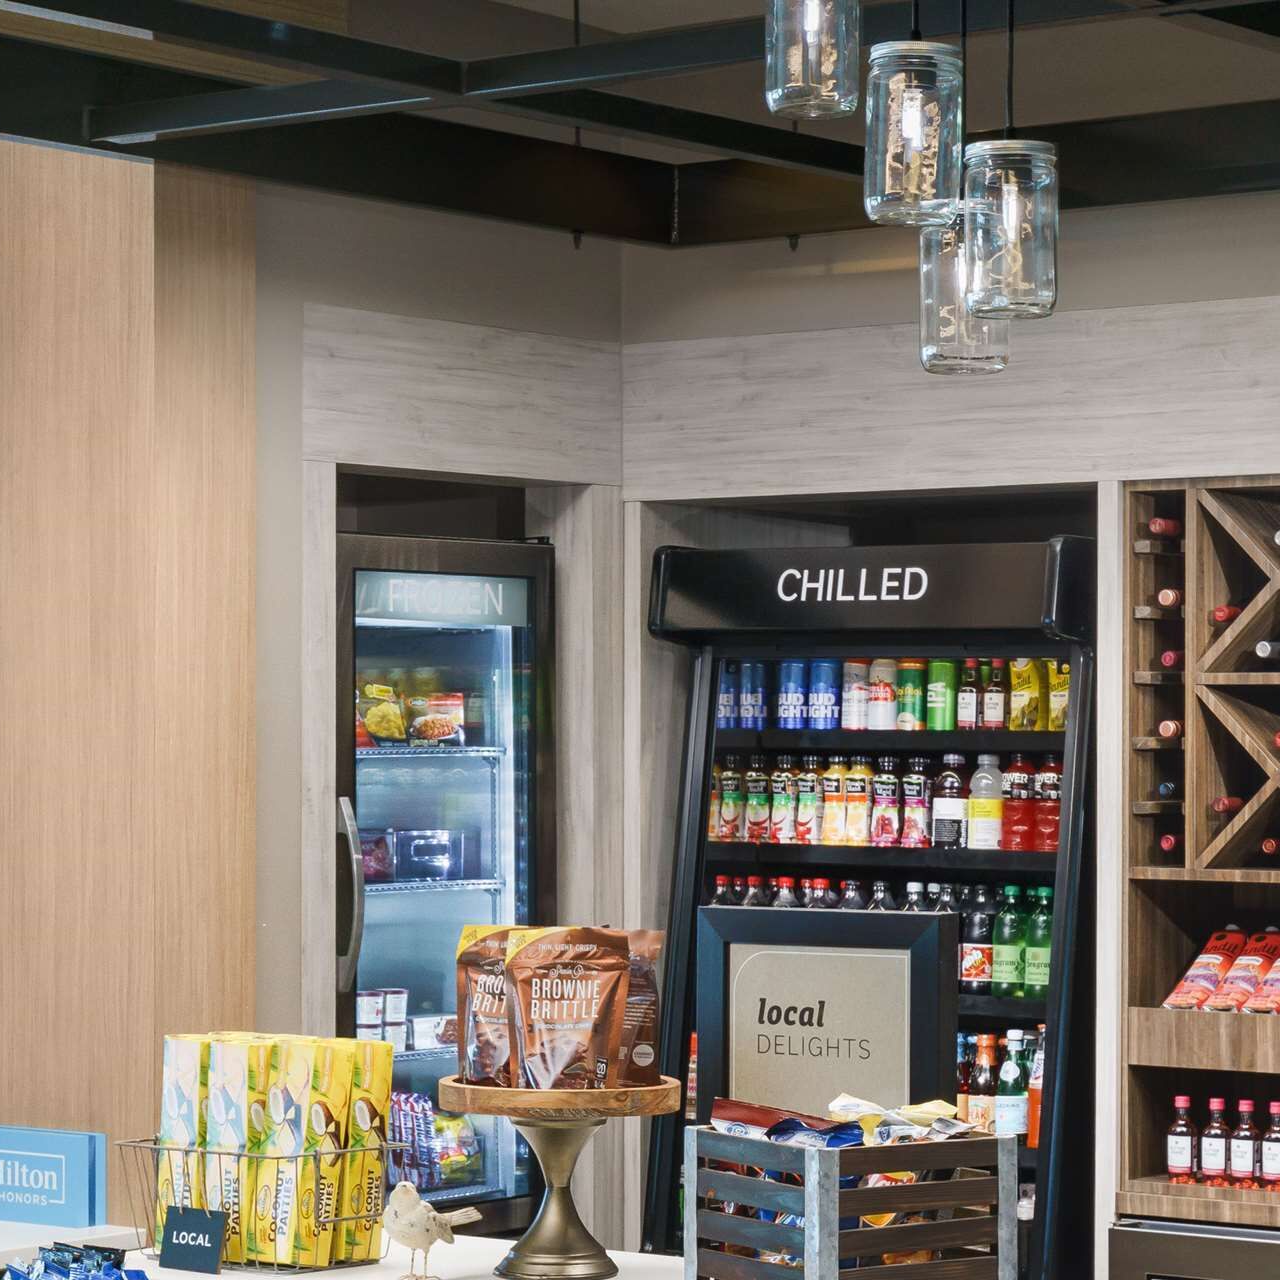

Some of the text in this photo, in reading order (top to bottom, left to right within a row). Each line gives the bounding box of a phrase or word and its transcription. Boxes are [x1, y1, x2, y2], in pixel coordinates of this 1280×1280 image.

[387, 578, 504, 616] FROZEN
[777, 566, 928, 602] CHILLED
[531, 978, 601, 998] BROWNIE
[530, 1000, 600, 1020] BRITTLE
[757, 998, 826, 1028] local
[757, 1034, 871, 1060] DELIGHTS
[172, 1231, 212, 1247] LOCAL
